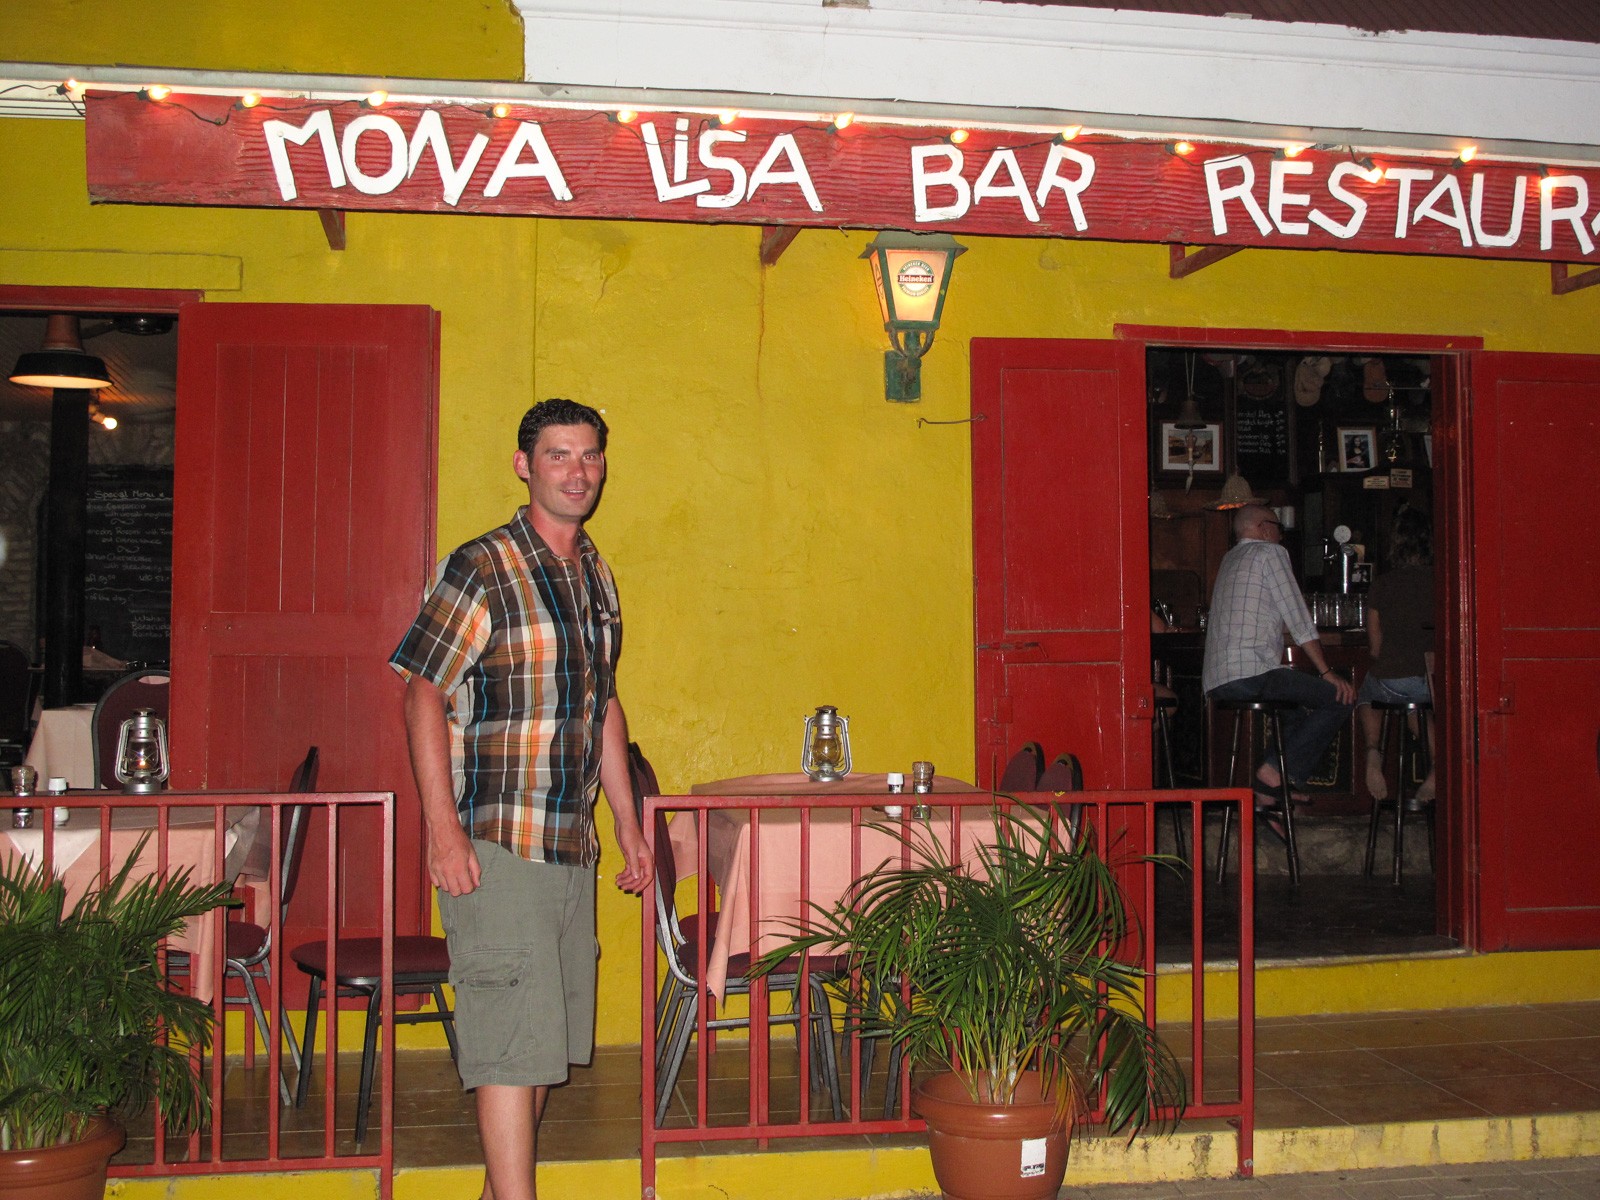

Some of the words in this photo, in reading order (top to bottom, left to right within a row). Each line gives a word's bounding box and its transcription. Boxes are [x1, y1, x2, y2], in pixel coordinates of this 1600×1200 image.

[263, 109, 574, 207] MONA
[910, 142, 1096, 232] BAR
[1203, 155, 1600, 256] RESTAUR
[900, 275, 933, 283] Heineken
